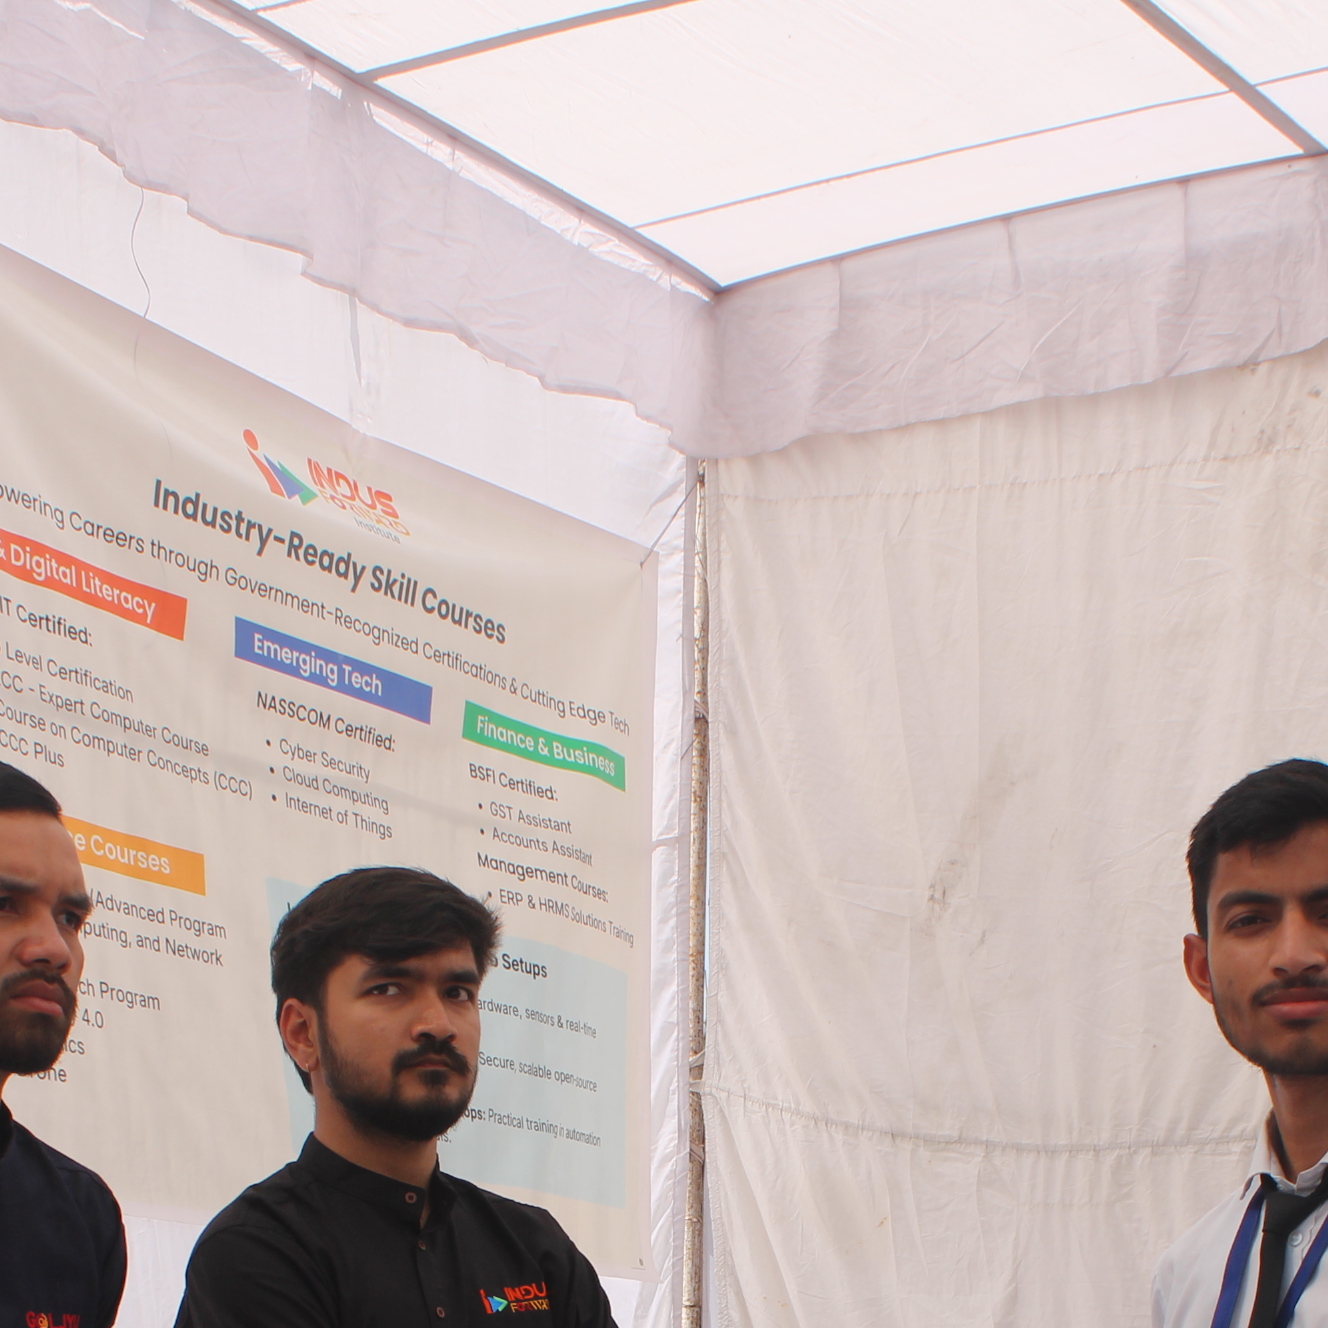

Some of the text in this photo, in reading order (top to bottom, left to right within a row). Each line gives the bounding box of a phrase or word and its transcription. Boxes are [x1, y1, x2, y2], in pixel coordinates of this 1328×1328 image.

[307, 457, 400, 520] INDUS
[354, 517, 401, 544] Institute
[10, 542, 77, 588] Digital
[81, 570, 156, 624] Literacy
[152, 479, 506, 644] Industry-Ready Skill Courses
[16, 603, 94, 647] Certified:
[69, 511, 145, 553] Careers
[150, 537, 219, 582] through
[224, 566, 419, 655] Government-Recognized
[423, 642, 507, 691] Certifications
[509, 677, 518, 695] &
[521, 683, 566, 719] Cutting
[569, 701, 606, 728] Edge
[609, 711, 630, 737] Tech
[5, 641, 43, 672] Level
[47, 659, 134, 703] Certification
[254, 633, 383, 697] Emerging Tech
[39, 685, 85, 717] Expert
[90, 700, 158, 740] Computer
[161, 726, 210, 757] Course
[256, 690, 396, 753] NASSCOM Certified:
[476, 714, 616, 776] Finance & Business
[33, 741, 65, 769] Plus
[50, 718, 67, 740] on
[71, 726, 143, 763] Computer
[147, 749, 209, 786] Concepts
[213, 771, 253, 801] (CCC)
[279, 738, 371, 783] Cyber Security
[282, 765, 390, 815] Cloud Computing
[469, 763, 558, 802] BSFI Certified:
[285, 791, 393, 840] Internet of Things
[489, 801, 572, 835] GST Assistant
[90, 834, 171, 875] Courses
[492, 826, 593, 867] Accounts Assistant
[477, 852, 609, 904] Management Courses:
[90, 888, 227, 940] (Advanced Program
[500, 889, 634, 948] ERP & HRMS Solutions Training
[80, 919, 224, 967] puting, and Network
[501, 953, 548, 980] Setups
[78, 978, 161, 1011] ch Program
[81, 1007, 104, 1029] 4.0
[477, 998, 597, 1038] ardware, sensors & real-time
[478, 1051, 597, 1092] Secure, scalable open-source
[488, 1108, 523, 1129] Practical
[525, 1117, 558, 1139] training
[565, 1128, 601, 1147] automation
[503, 1281, 547, 1301] INDU
